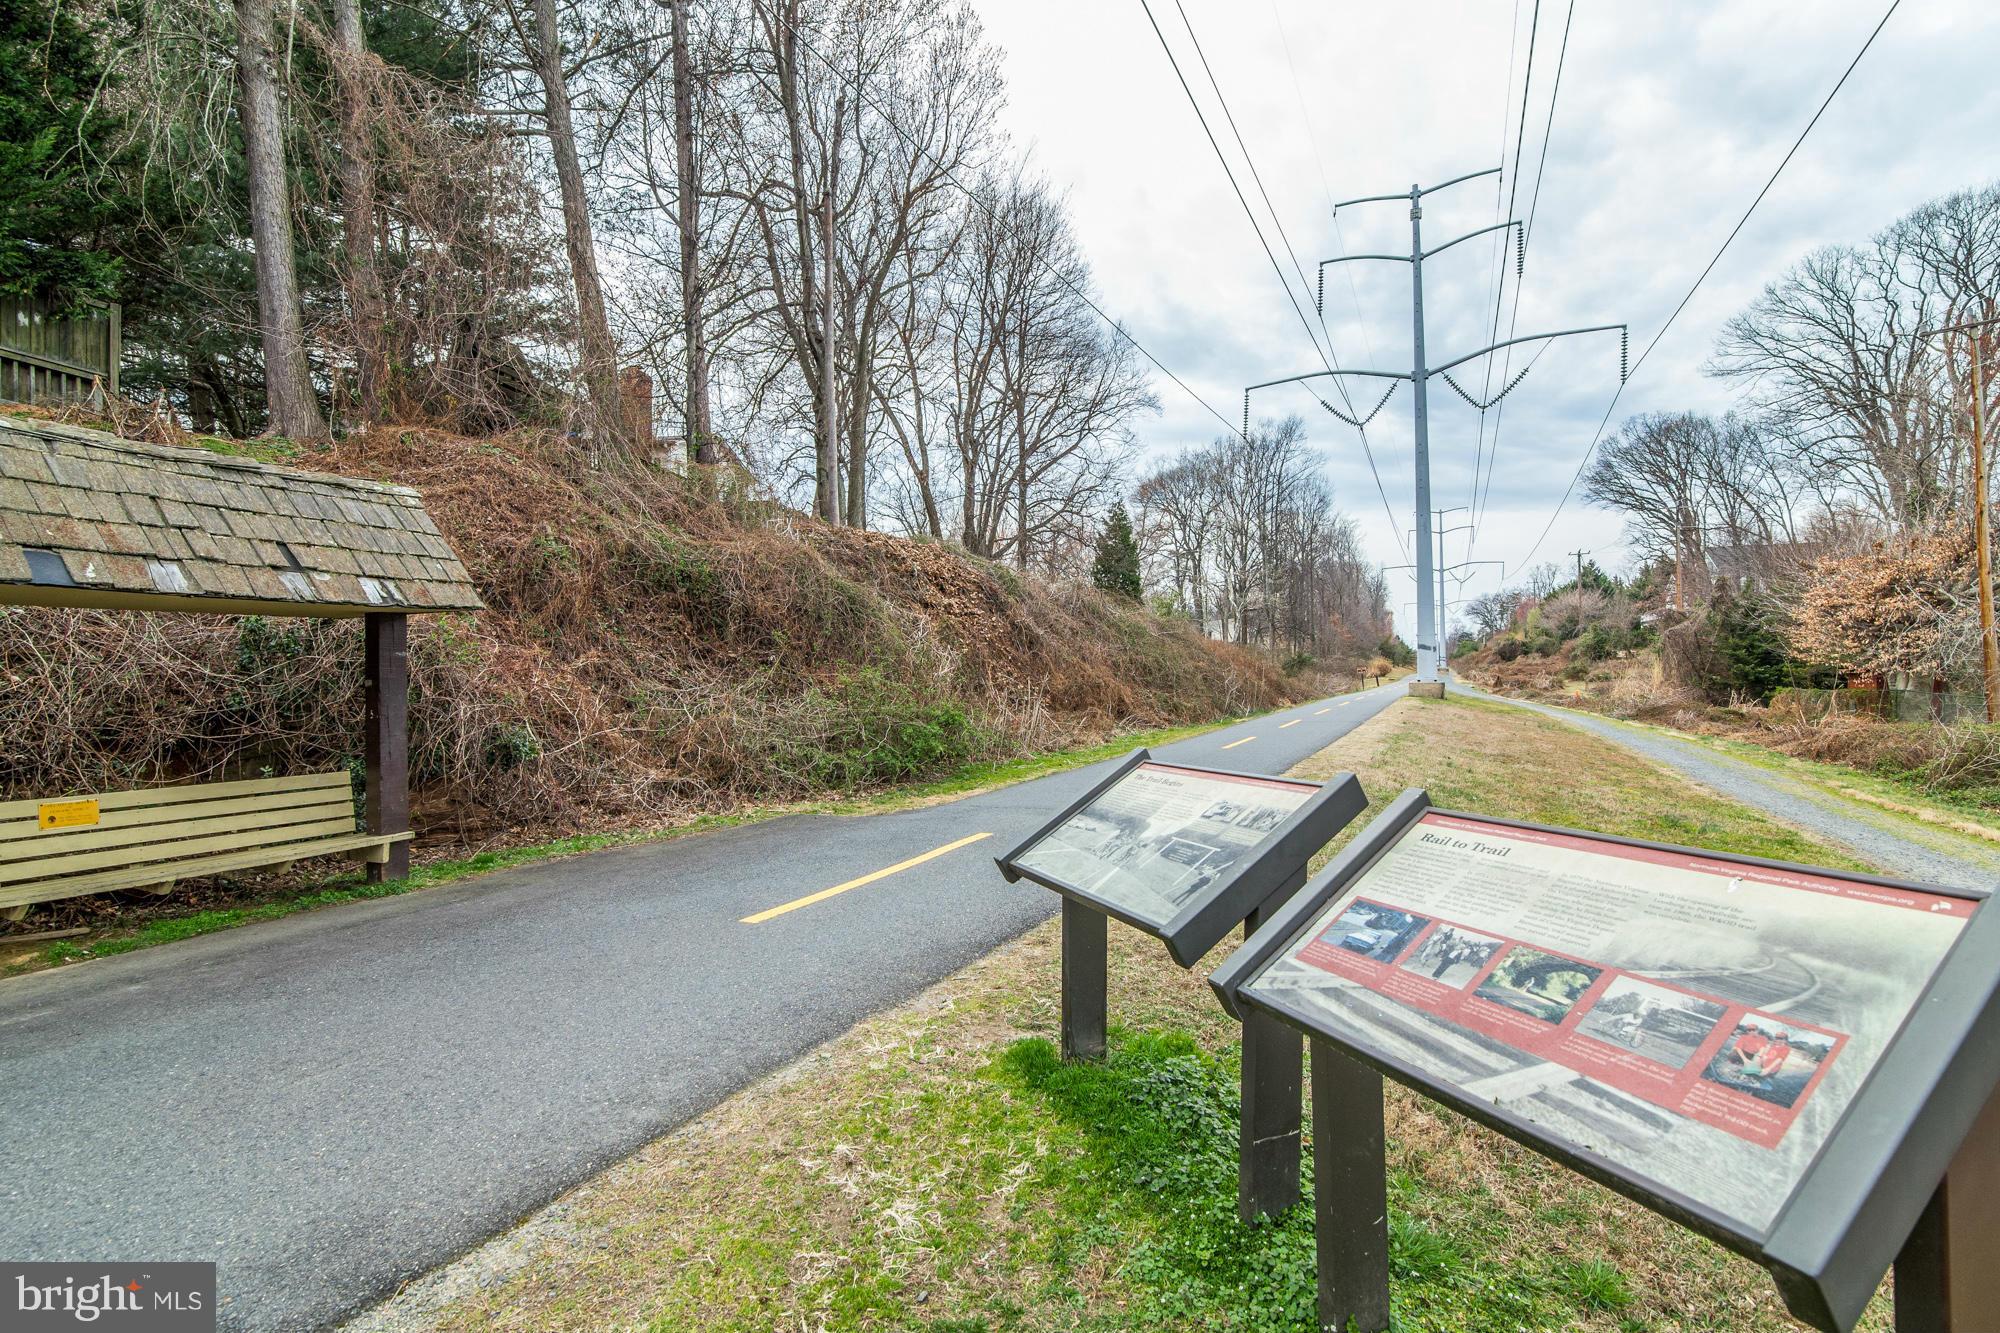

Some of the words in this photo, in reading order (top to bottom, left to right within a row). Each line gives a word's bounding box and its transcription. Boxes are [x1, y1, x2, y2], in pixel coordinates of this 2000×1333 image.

[1420, 832, 1452, 847] Rail
[1452, 839, 1468, 849] to
[1472, 842, 1512, 857] Trail
[1748, 872, 1781, 882] Regional
[1782, 876, 1800, 884] Park
[1801, 880, 1840, 893] Authority
